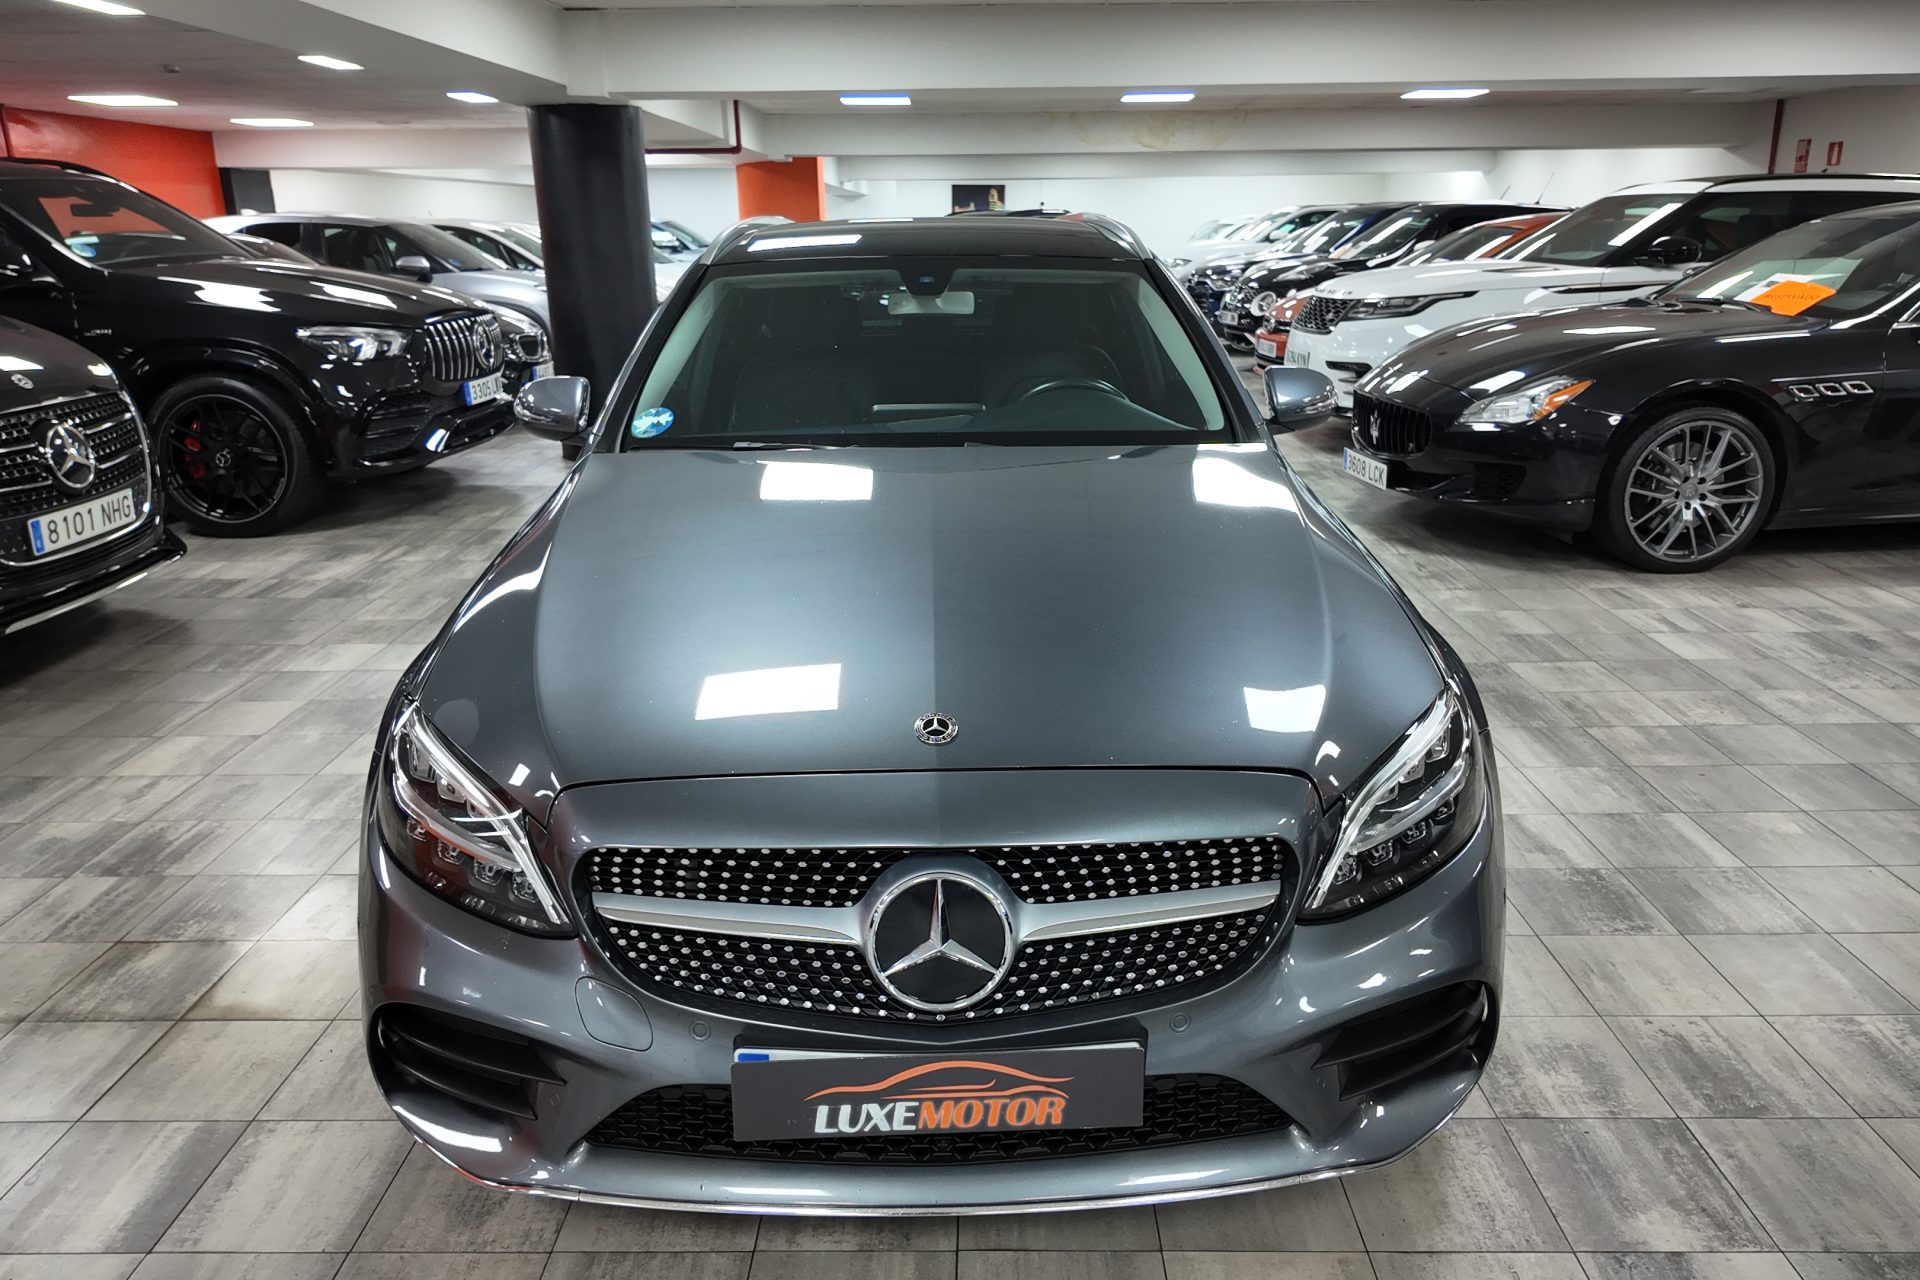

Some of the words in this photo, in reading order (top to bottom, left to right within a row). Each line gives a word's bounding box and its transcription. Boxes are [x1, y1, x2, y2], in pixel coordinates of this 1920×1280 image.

[1348, 453, 1366, 477] 3608
[1368, 462, 1385, 487] LCK
[47, 507, 94, 544] 8101
[101, 495, 131, 527] NHG
[814, 1096, 1066, 1133] LUXEMOTOR
